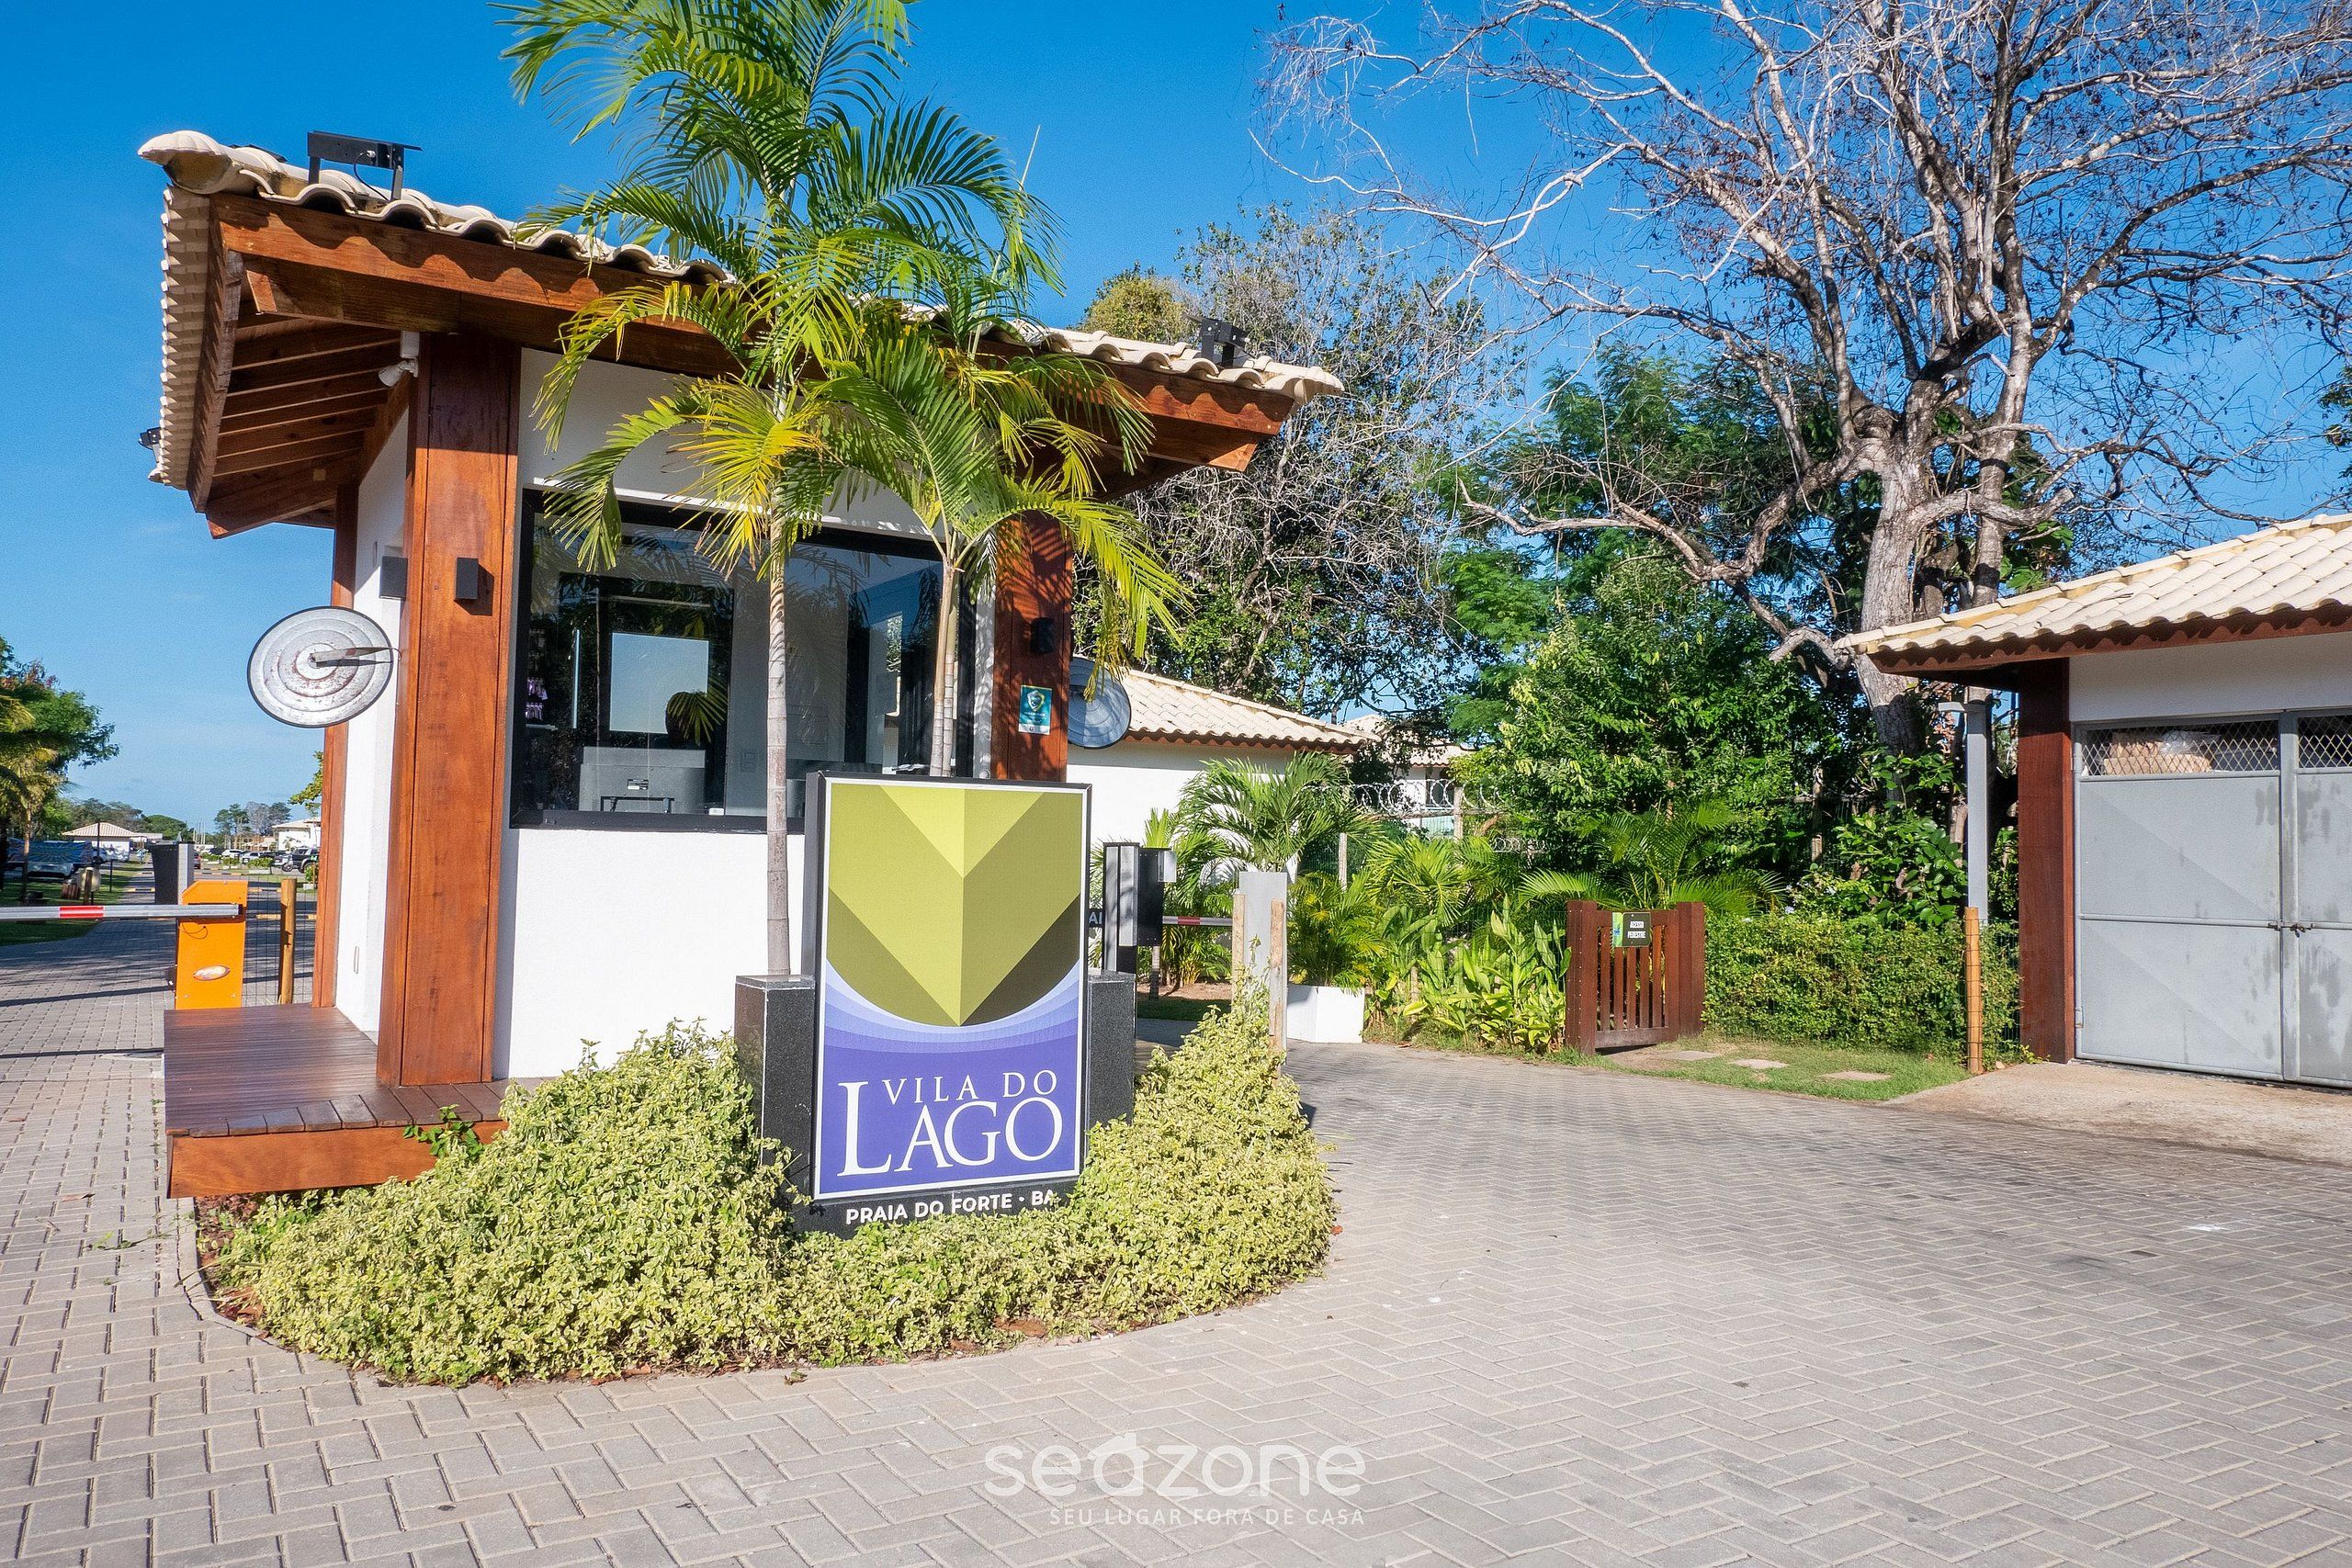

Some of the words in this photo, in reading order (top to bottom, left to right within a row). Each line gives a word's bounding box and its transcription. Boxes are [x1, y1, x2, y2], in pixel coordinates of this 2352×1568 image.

[882, 1074, 978, 1105] VILA
[1002, 1069, 1057, 1098] DO
[837, 1081, 1063, 1177] LAGO
[846, 1203, 909, 1225] PRAIA
[914, 1201, 944, 1218] DO
[951, 1193, 1013, 1214] FORTE
